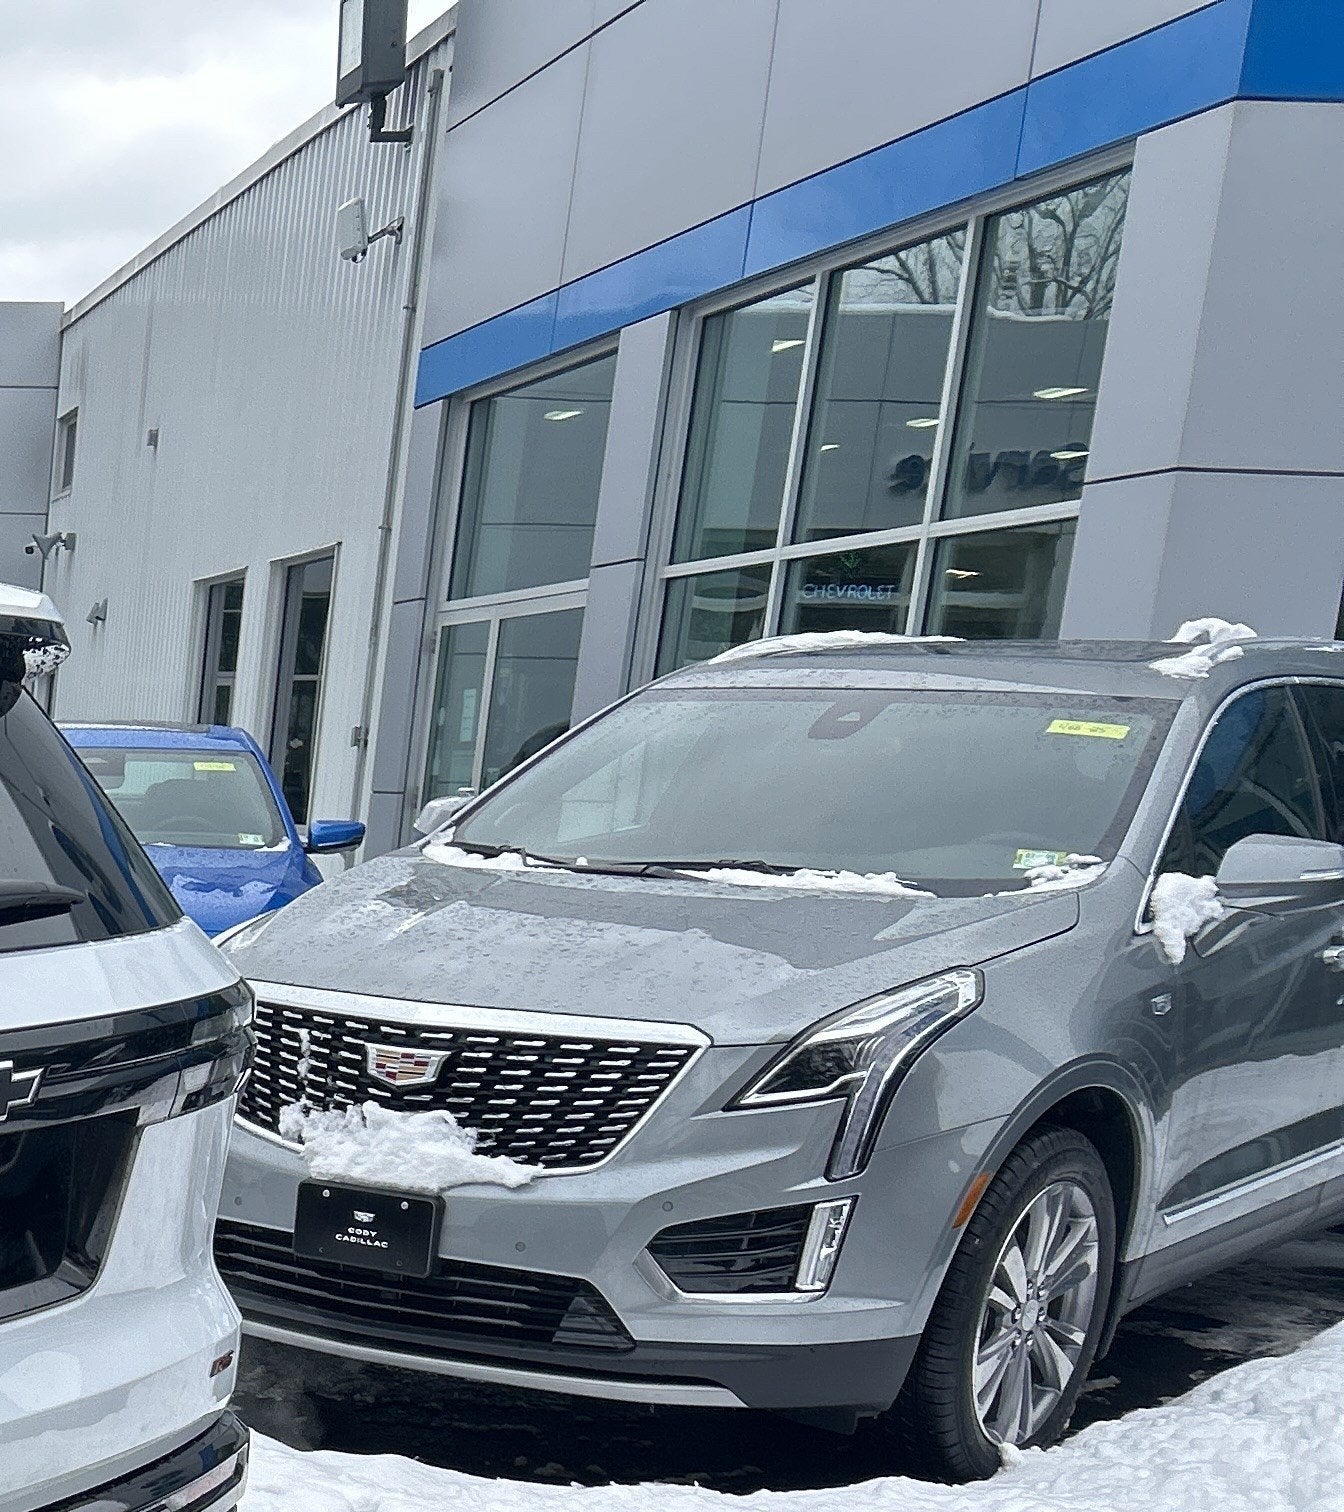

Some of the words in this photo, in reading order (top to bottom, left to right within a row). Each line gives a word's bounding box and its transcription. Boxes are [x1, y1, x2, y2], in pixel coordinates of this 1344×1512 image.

[802, 583, 895, 600] CHEVROLET
[347, 1226, 378, 1238] CODY
[335, 1233, 389, 1249] CADILLAC
